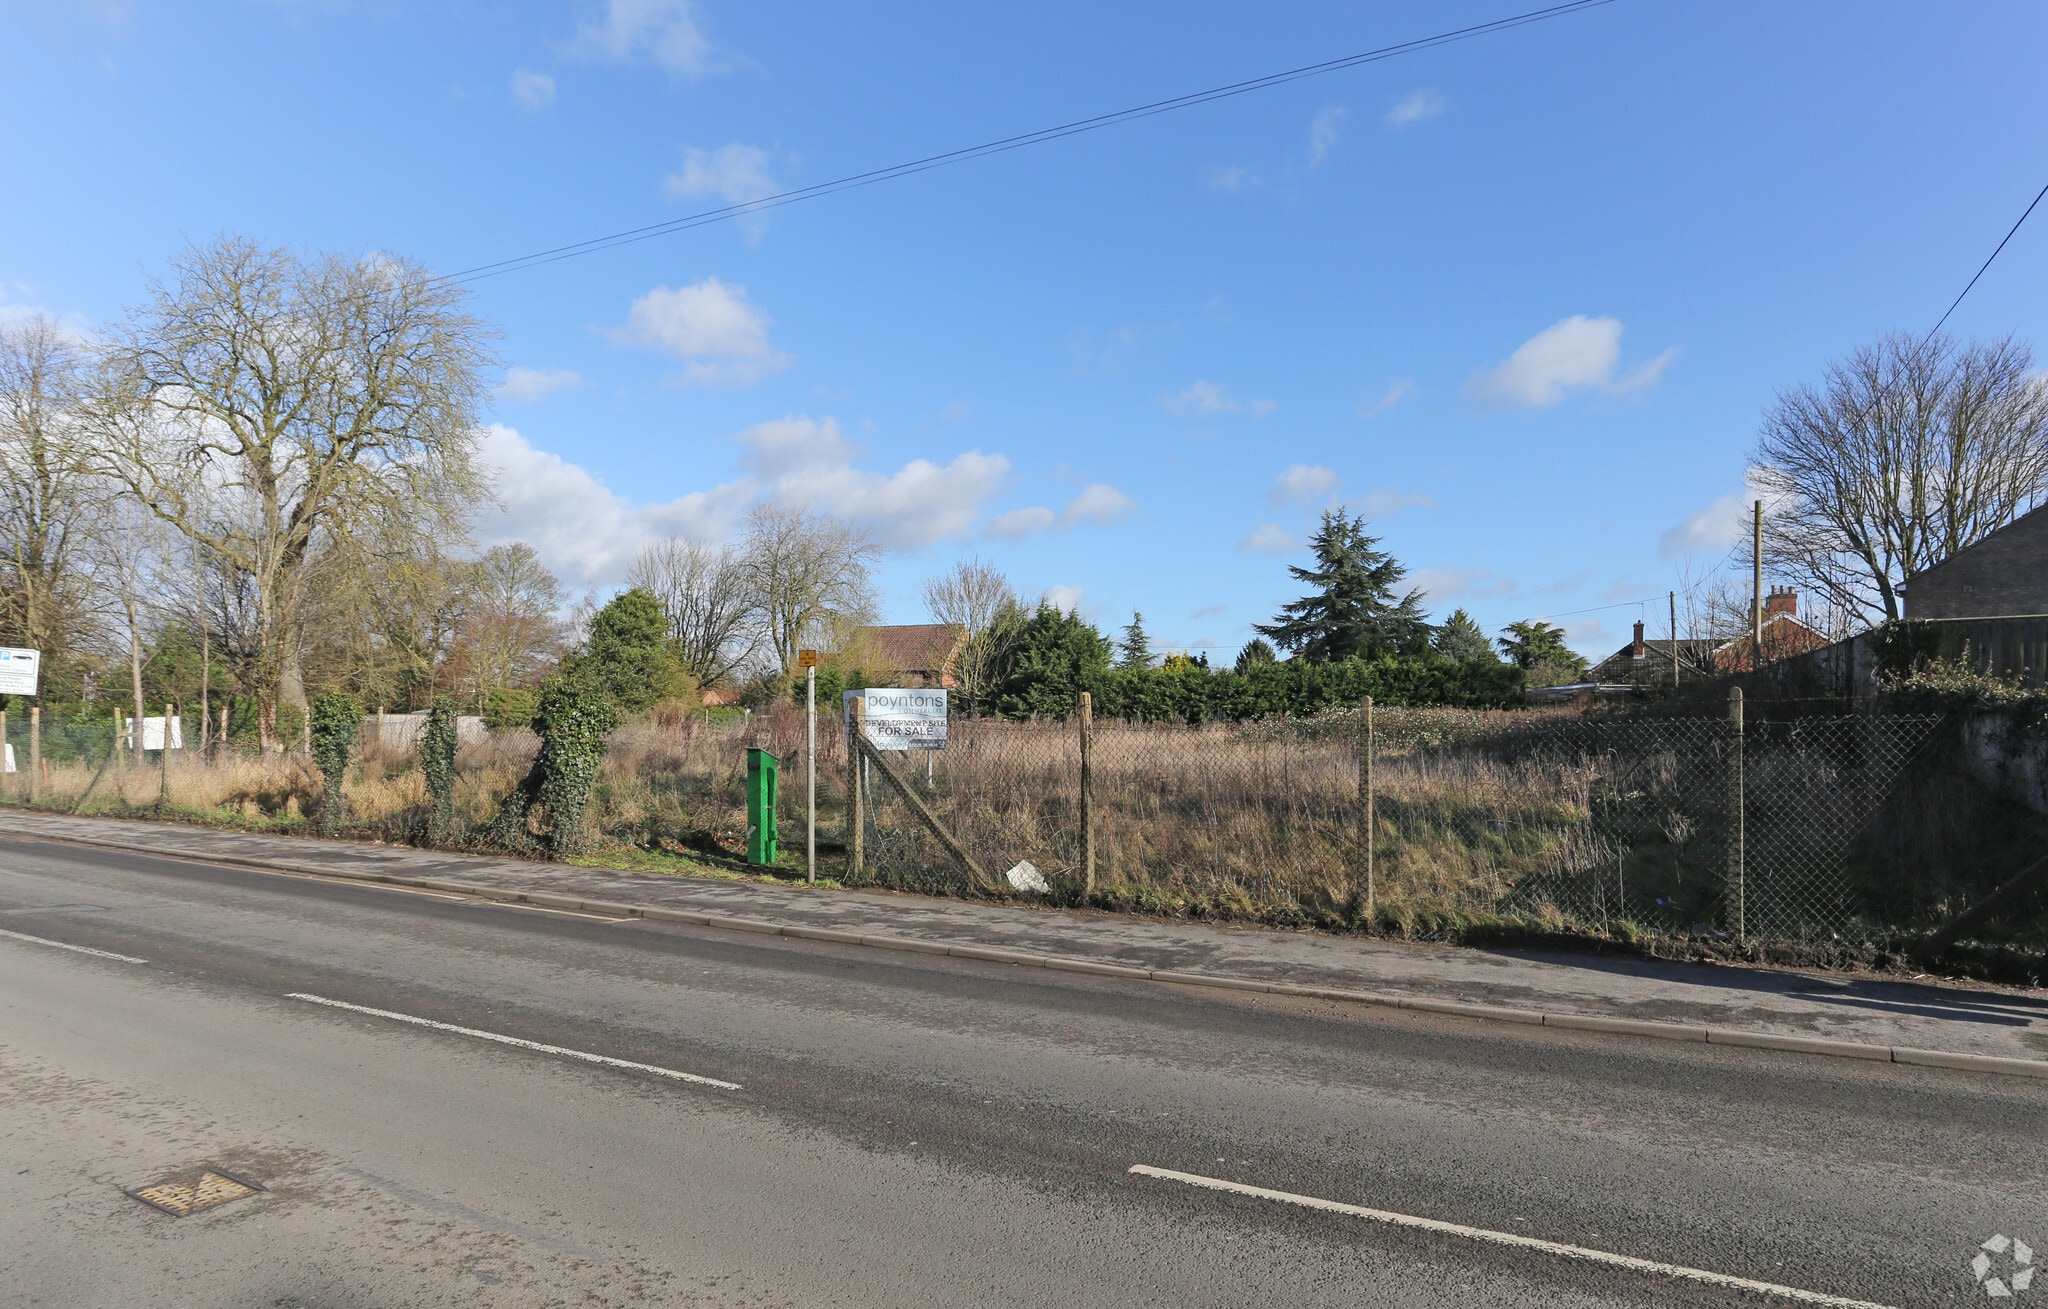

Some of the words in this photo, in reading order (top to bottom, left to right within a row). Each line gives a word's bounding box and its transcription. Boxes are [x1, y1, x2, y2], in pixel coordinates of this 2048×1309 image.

[868, 694, 944, 710] poyntons
[878, 727, 901, 736] FOR
[905, 727, 934, 736] SALE
